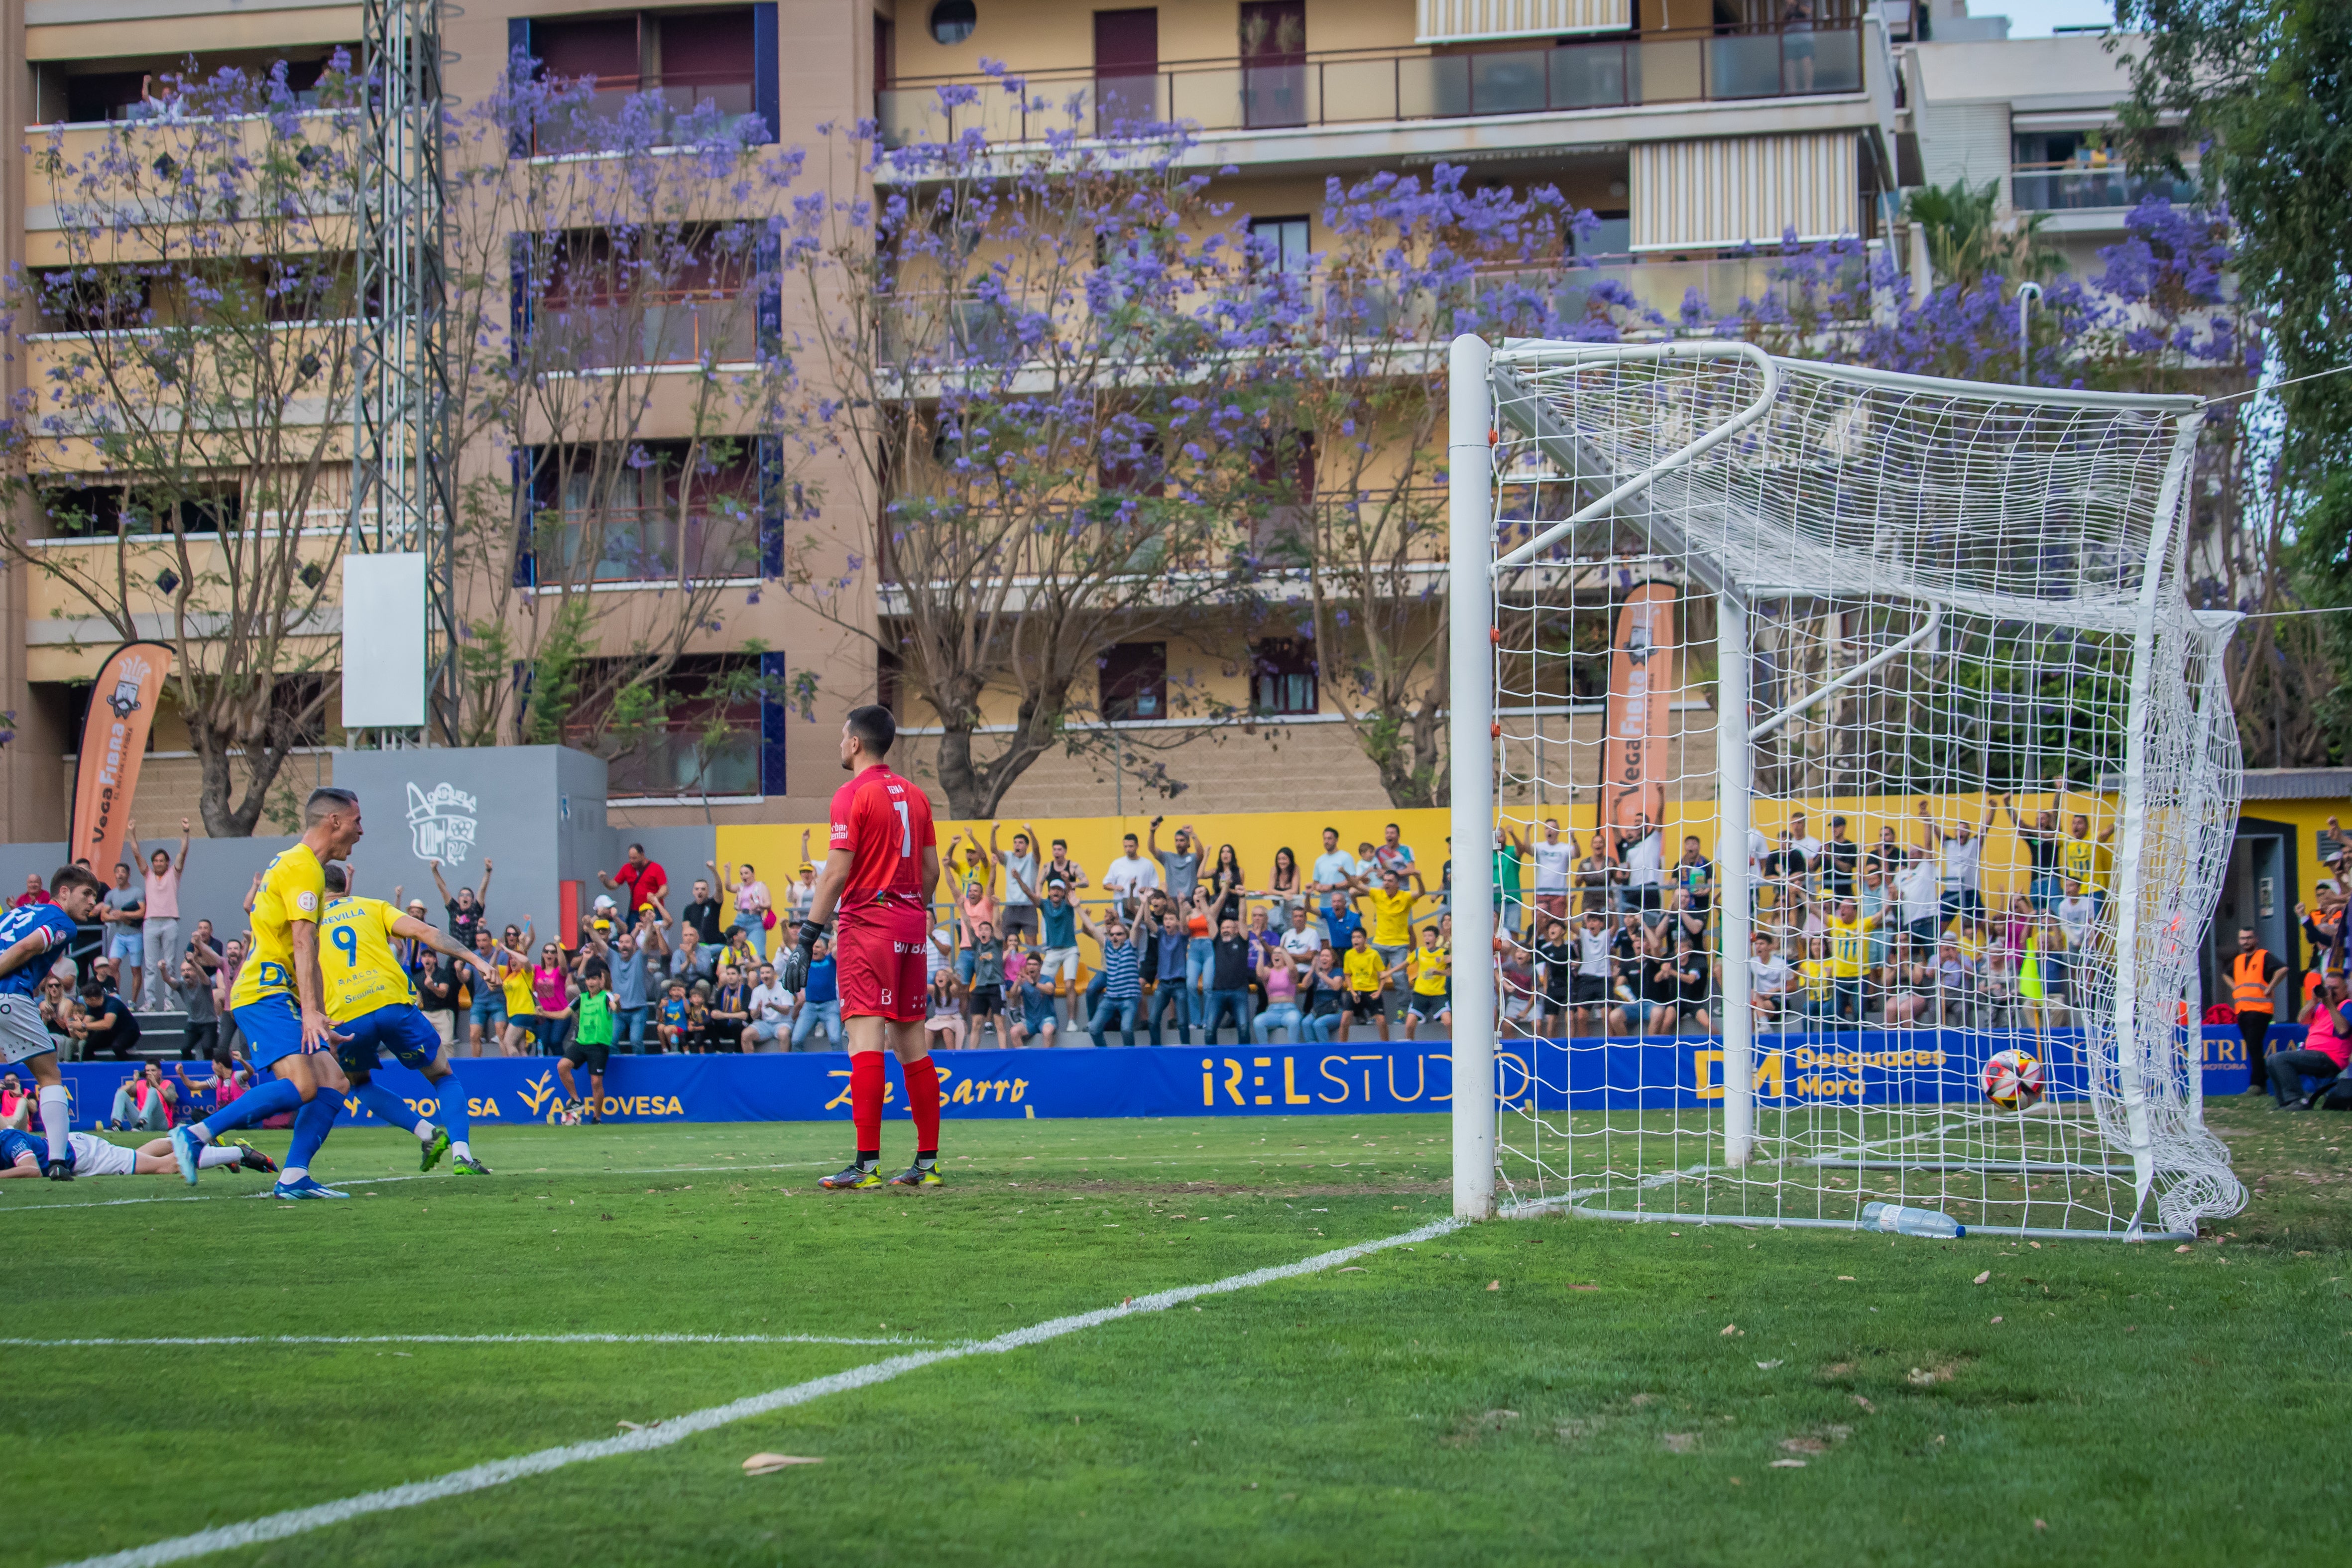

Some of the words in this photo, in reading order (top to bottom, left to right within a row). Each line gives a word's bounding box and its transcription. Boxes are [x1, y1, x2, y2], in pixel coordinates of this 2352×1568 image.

[831, 822, 847, 832] rban
[332, 925, 357, 967] 9
[1795, 1048, 1947, 1074] Desguaces
[1796, 1076, 1867, 1096] Mora
